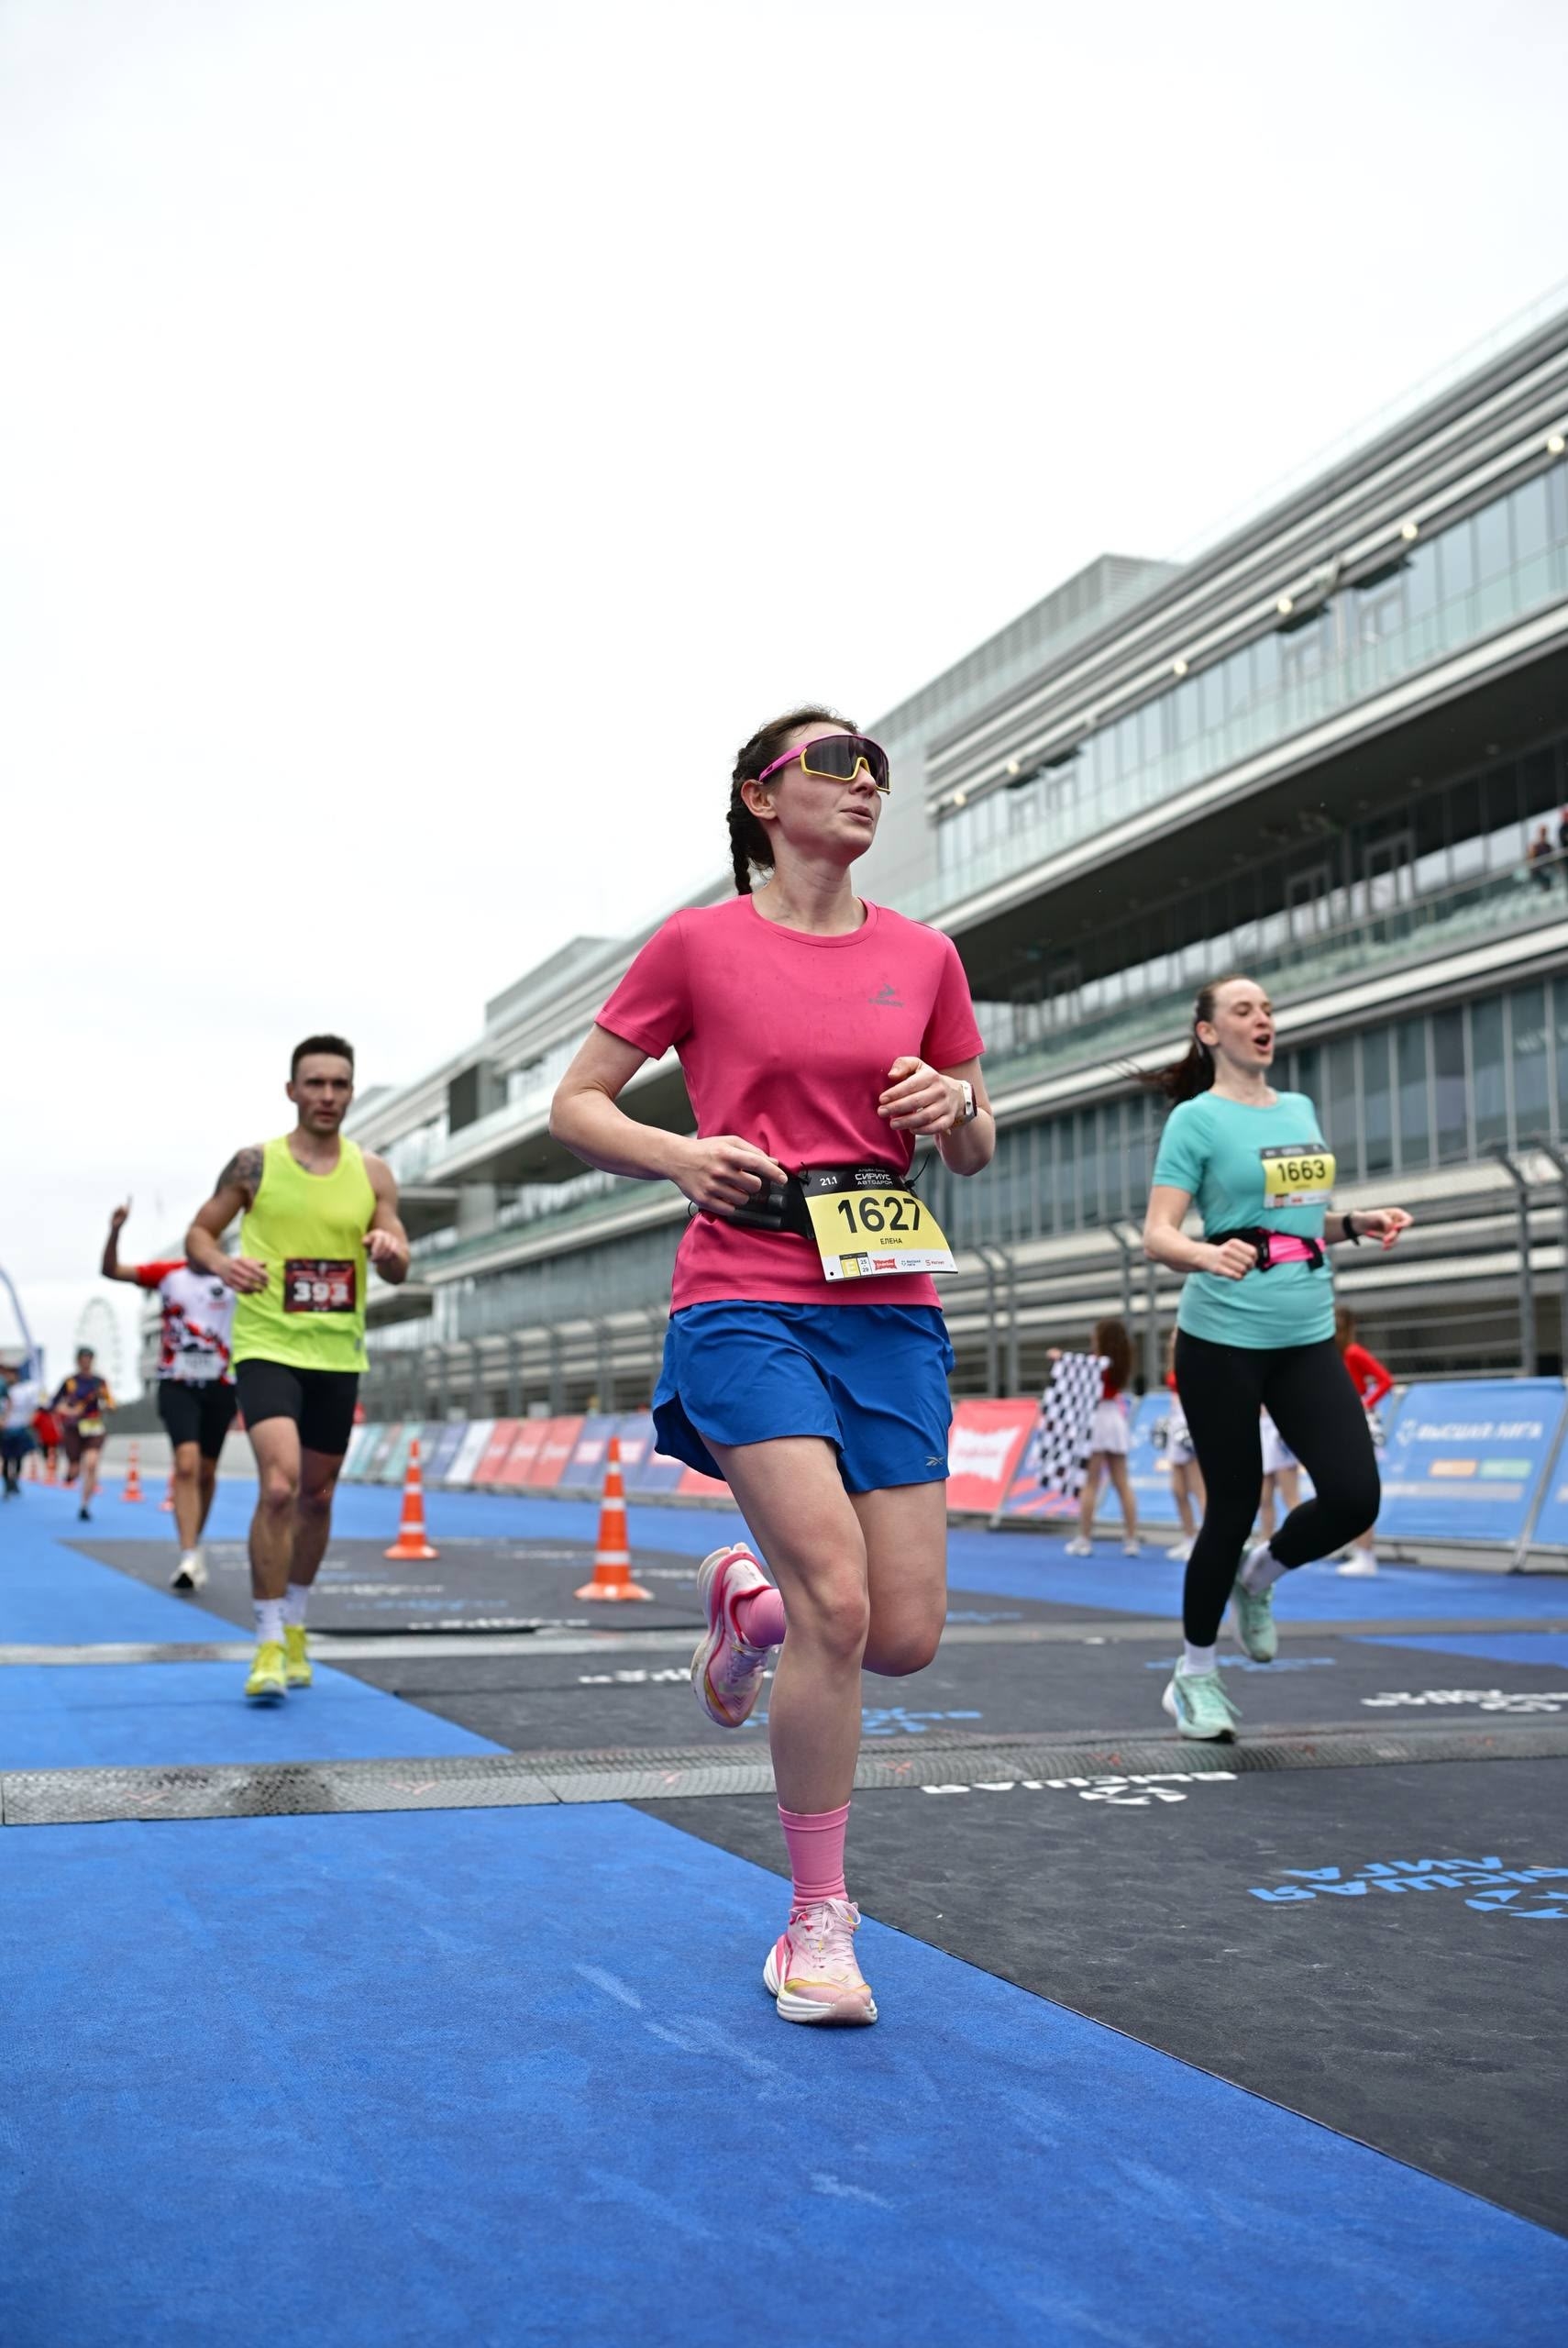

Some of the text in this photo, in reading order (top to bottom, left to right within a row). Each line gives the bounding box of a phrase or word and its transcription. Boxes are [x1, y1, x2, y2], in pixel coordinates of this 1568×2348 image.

[820, 1176, 838, 1186] 21.1
[1277, 1160, 1326, 1182] 1663
[837, 1196, 921, 1234] 1627
[880, 1237, 903, 1246] ЕЛЕНА
[1282, 1856, 1503, 1881] ЛИГА
[1247, 1867, 1568, 1901] ЫСШАЯ
